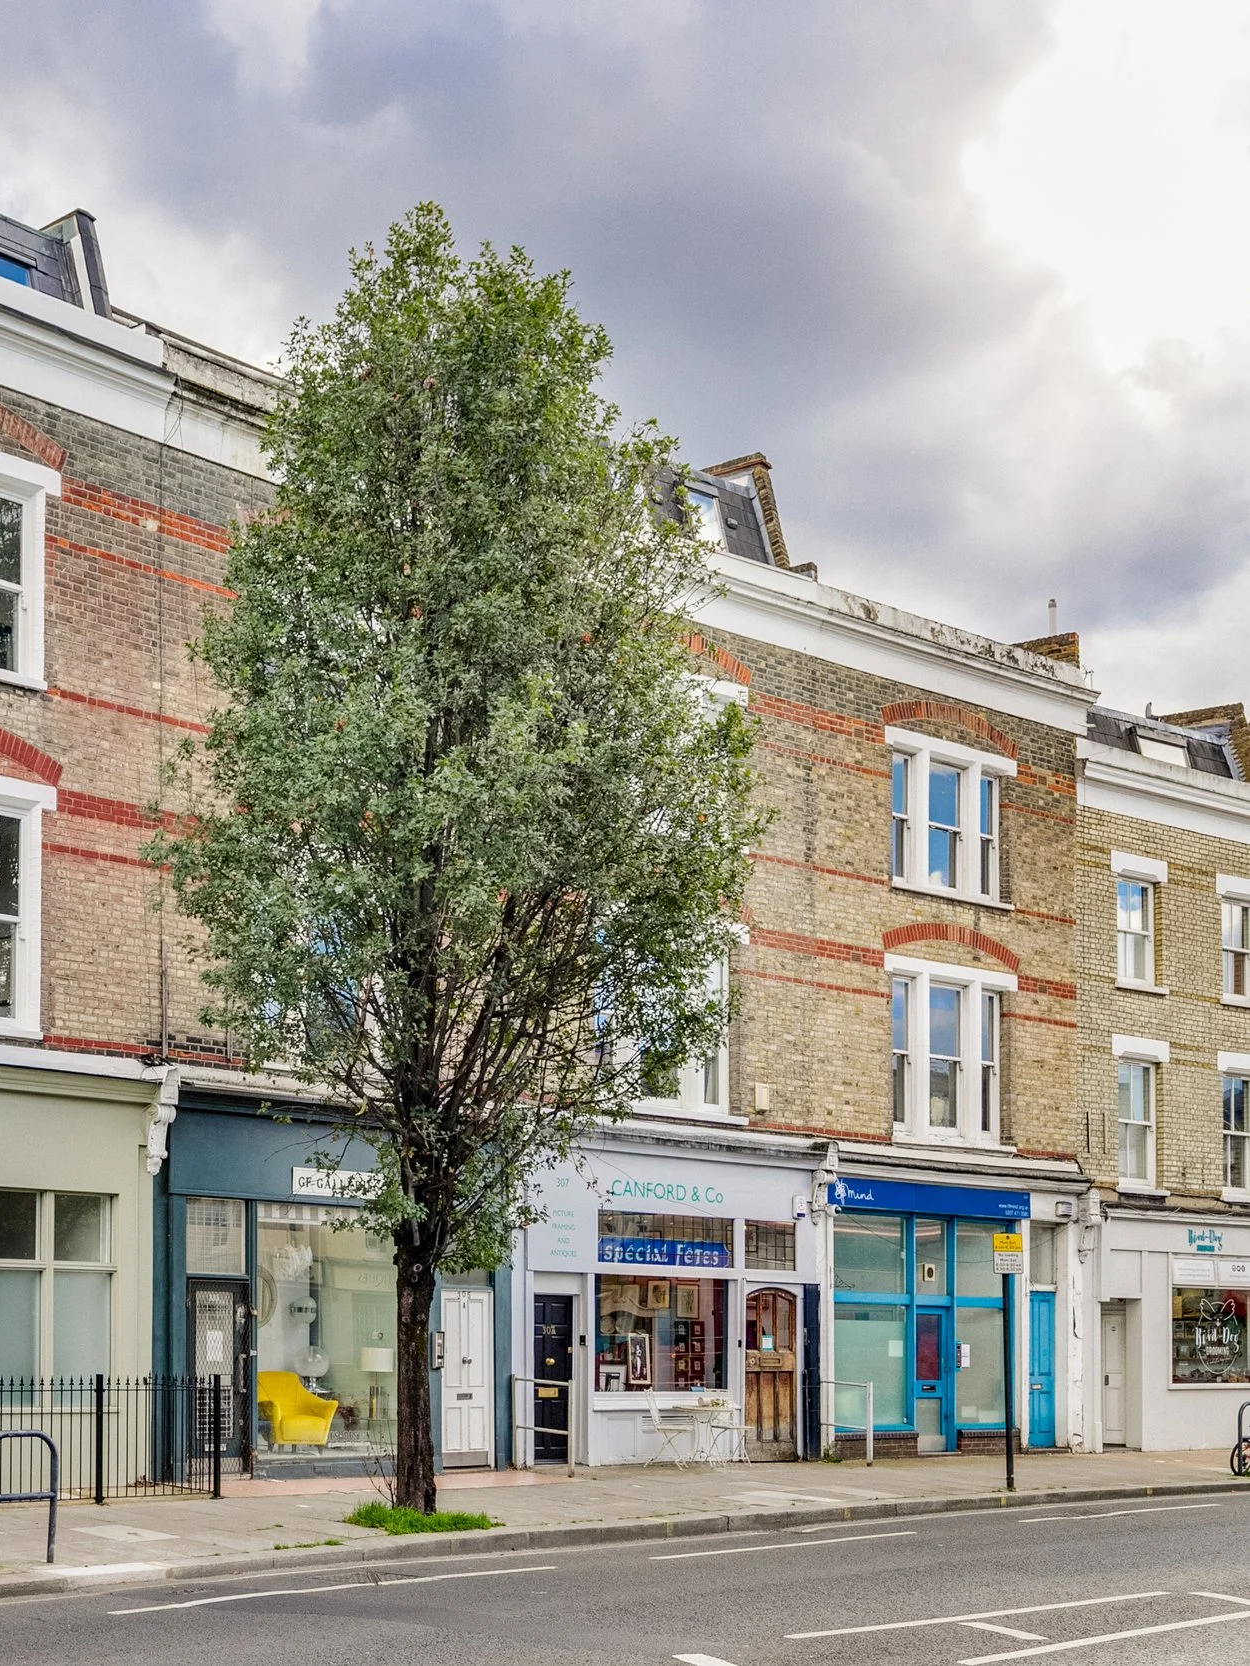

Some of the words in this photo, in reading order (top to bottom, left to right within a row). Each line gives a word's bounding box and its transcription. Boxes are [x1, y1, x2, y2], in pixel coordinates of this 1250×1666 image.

[556, 1178, 570, 1188] 307
[611, 1179, 687, 1202] CANFORD
[691, 1187, 701, 1203] &
[705, 1187, 724, 1204] Co
[847, 1188, 875, 1201] mind
[552, 1209, 575, 1218] PICTURE
[551, 1223, 576, 1231] FRAMING
[557, 1237, 570, 1245] AND
[549, 1250, 577, 1258] ANTIQUES
